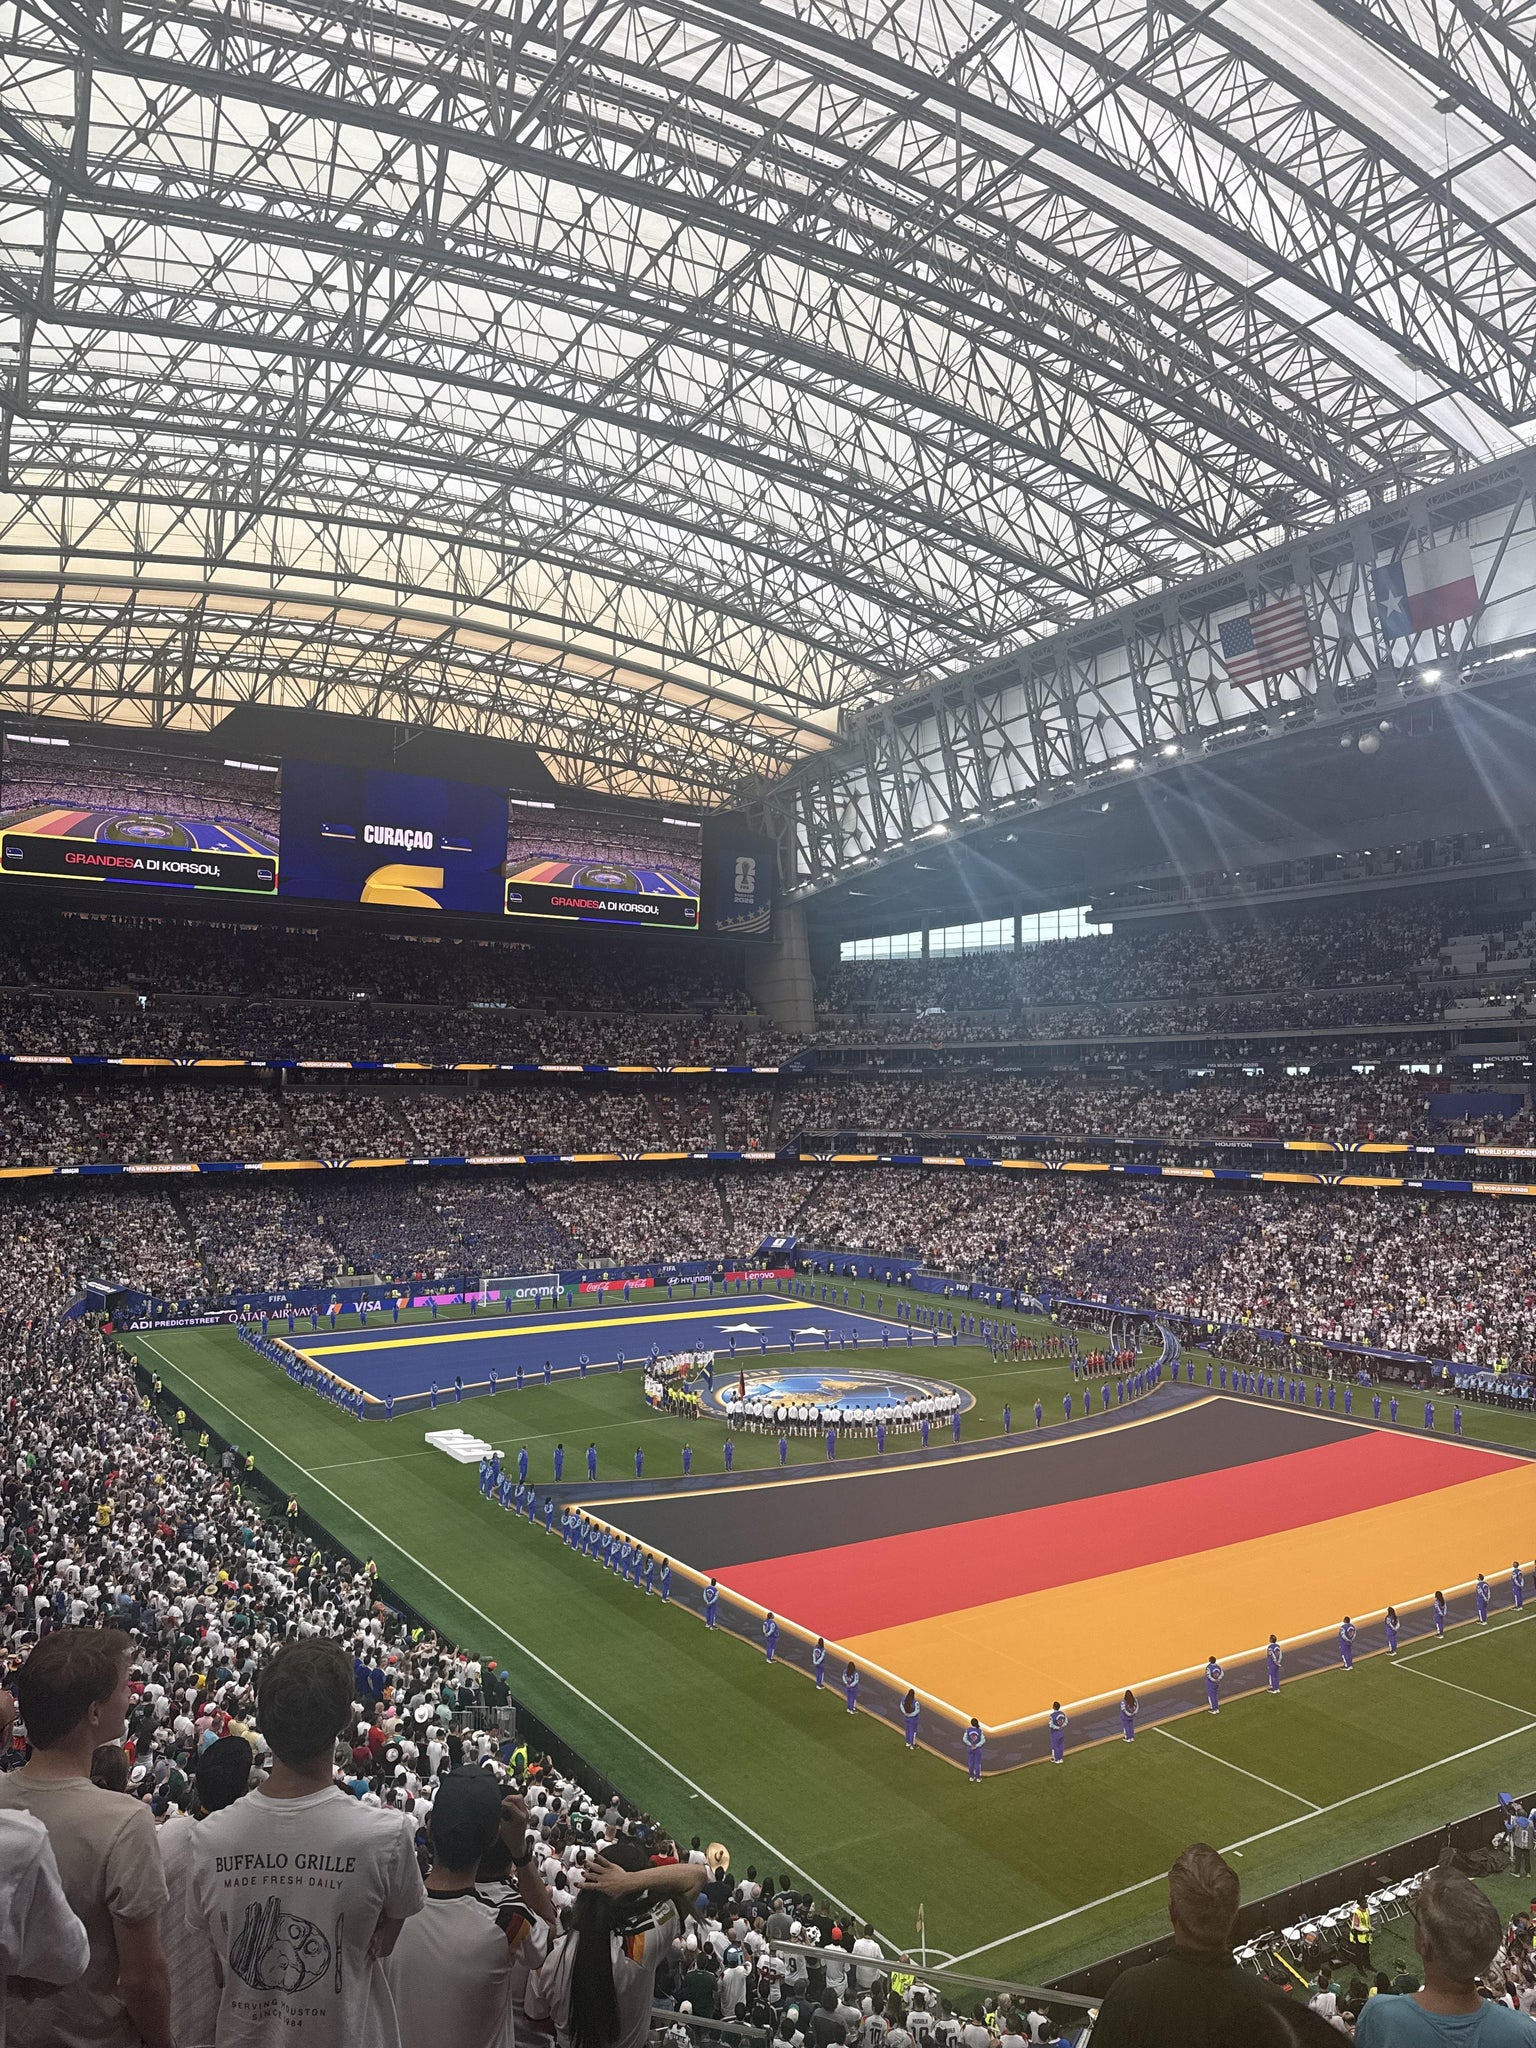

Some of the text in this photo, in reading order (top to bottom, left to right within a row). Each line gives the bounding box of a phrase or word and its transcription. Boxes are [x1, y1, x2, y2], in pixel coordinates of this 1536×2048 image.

[363, 824, 434, 851] CURAÇAO
[65, 852, 221, 878] GRANDESA DI KORSOU;
[551, 896, 606, 911] GRANDESA
[607, 901, 618, 912] DI
[745, 1272, 774, 1280] Lenovo
[269, 1295, 287, 1303] FIFA
[354, 1301, 382, 1312] VISA
[228, 1306, 318, 1323] QATAR AIRWAYS
[130, 1317, 220, 1330] ADI PREDICTSTREET
[216, 1853, 356, 1873] BUFFALO GRILLE
[224, 1875, 344, 1889] MADE FRESH DAILY
[231, 1999, 326, 2017] SERVING HOUSTON
